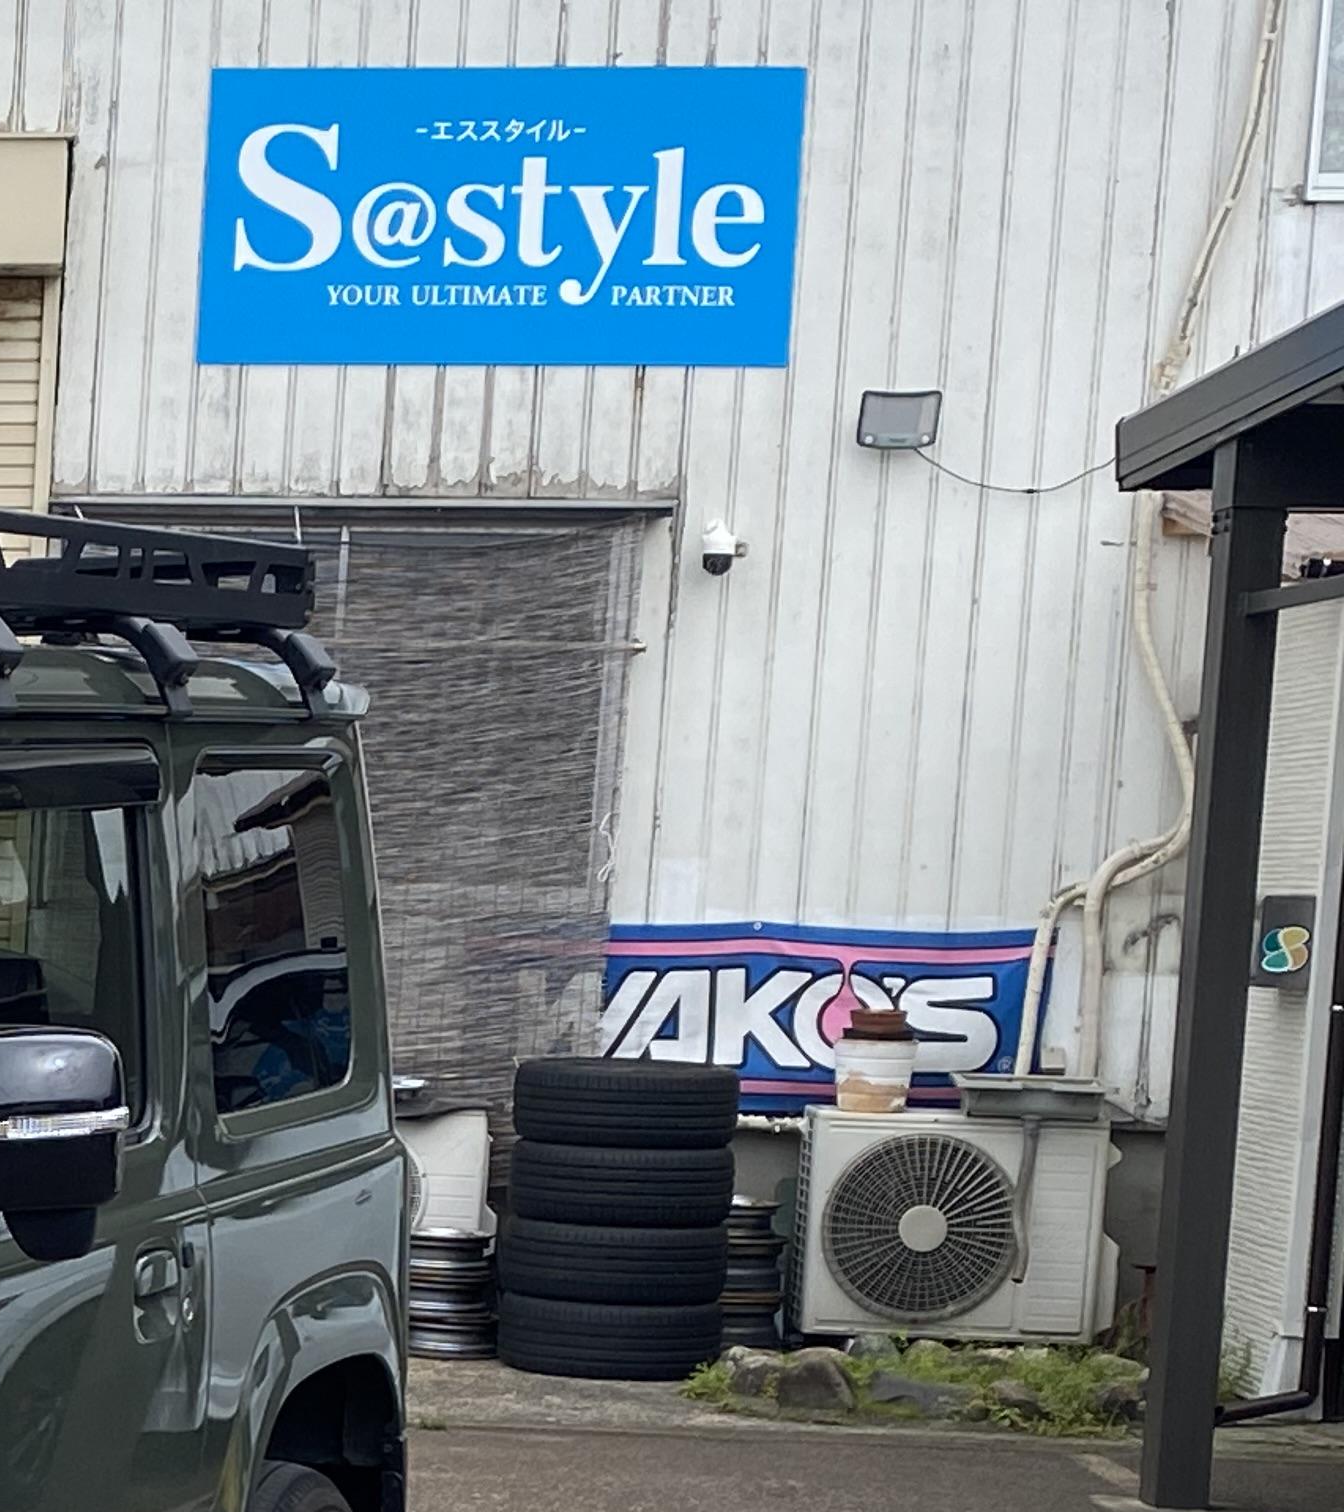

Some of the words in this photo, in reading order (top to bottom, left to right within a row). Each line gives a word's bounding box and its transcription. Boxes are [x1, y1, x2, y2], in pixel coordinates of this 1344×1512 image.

[233, 122, 765, 305] S@style
[326, 284, 401, 307] YOUR
[411, 284, 547, 307] ULTIMATE
[610, 284, 736, 308] PARTNER
